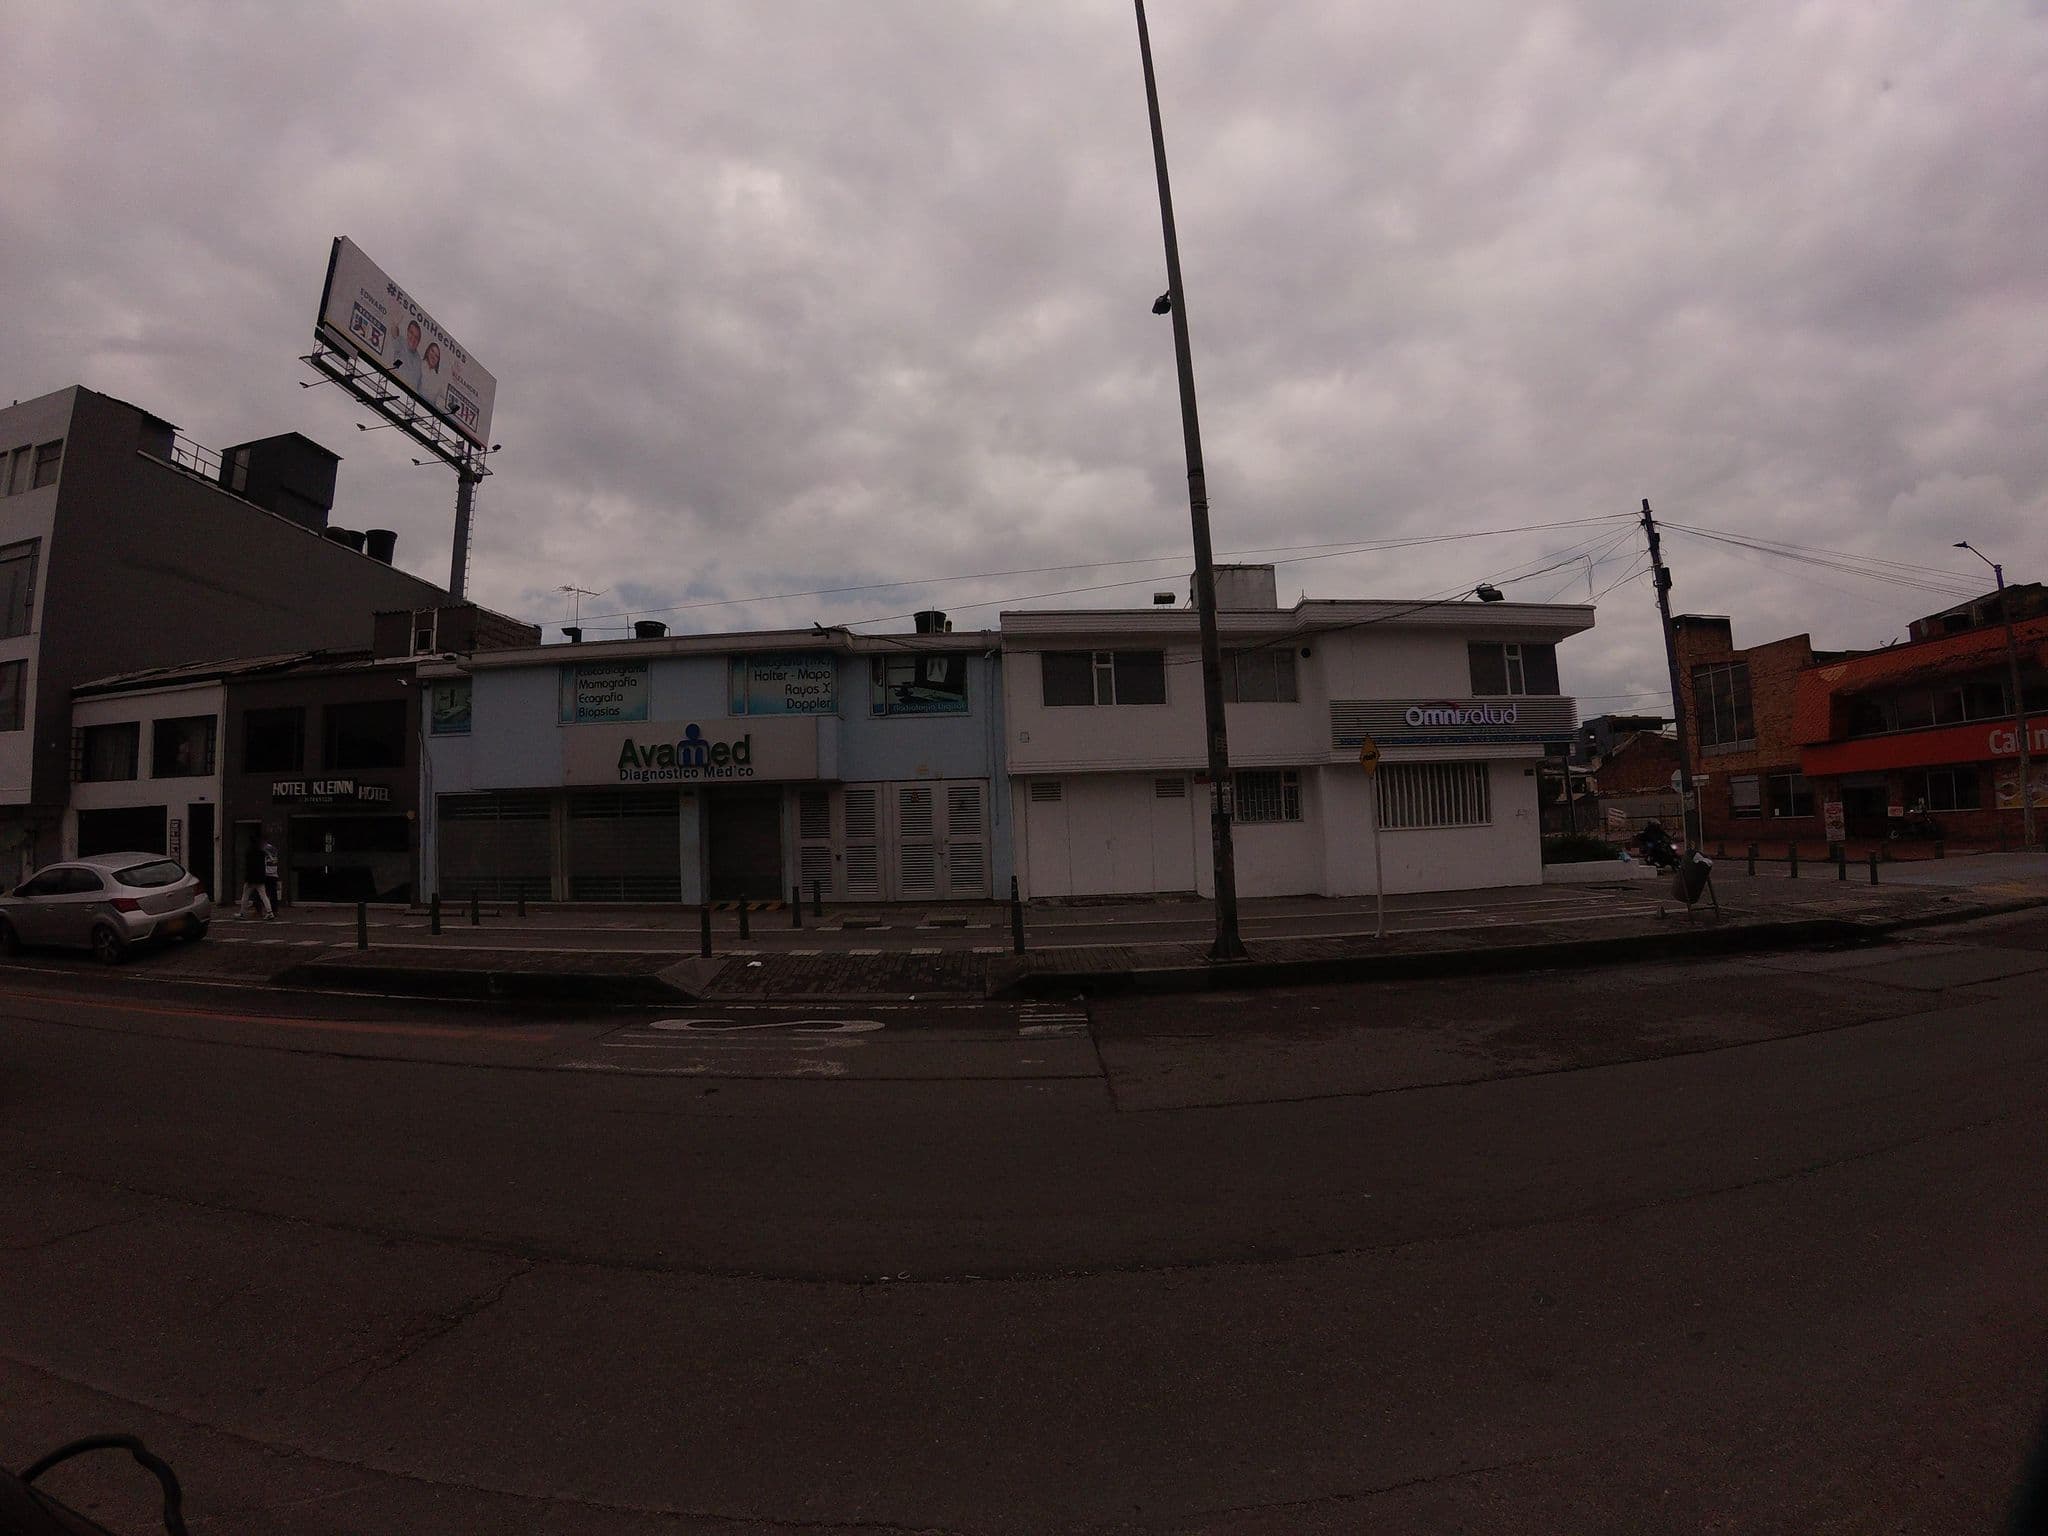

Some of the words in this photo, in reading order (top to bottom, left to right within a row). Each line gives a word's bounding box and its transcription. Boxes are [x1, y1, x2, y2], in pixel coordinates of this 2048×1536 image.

[754, 670, 788, 681] Holter
[785, 683, 820, 697] Rayos
[822, 682, 831, 693] X
[786, 697, 831, 711] Doppler
[578, 707, 620, 719] Biopsias
[618, 733, 752, 767] Avamed
[619, 767, 698, 782] Diagnóstico
[271, 781, 307, 796] HOTEL
[358, 785, 392, 801] HOTEL
